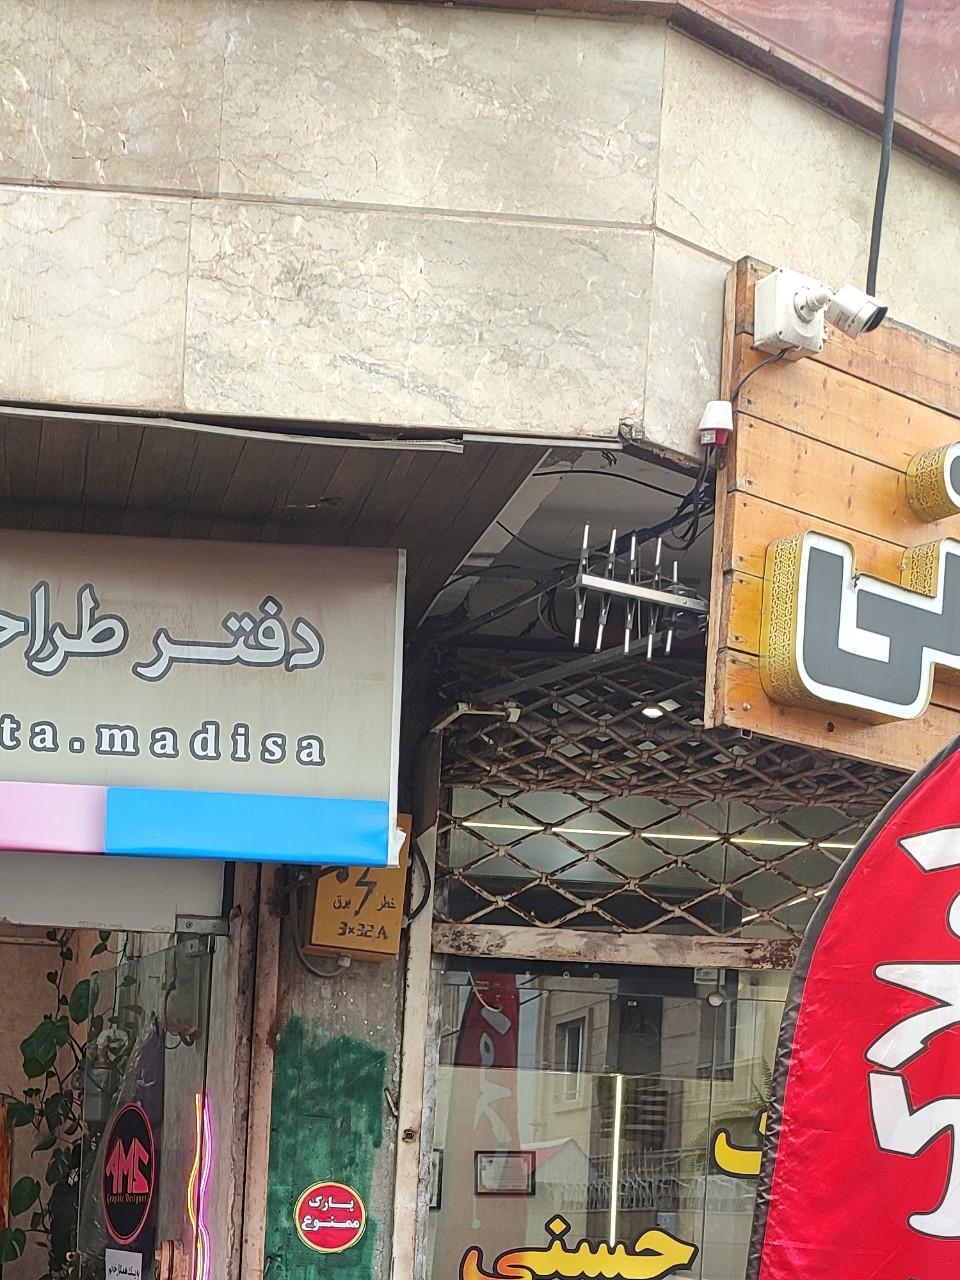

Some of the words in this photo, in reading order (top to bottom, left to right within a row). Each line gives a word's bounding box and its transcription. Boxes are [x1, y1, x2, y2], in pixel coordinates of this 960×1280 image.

[132, 596, 325, 681] دفتر
[333, 895, 352, 910] برق
[377, 895, 396, 911] خطر
[865, 825, 960, 1239] الاک
[308, 1195, 355, 1212] پارک
[300, 1212, 360, 1232] ممنوع
